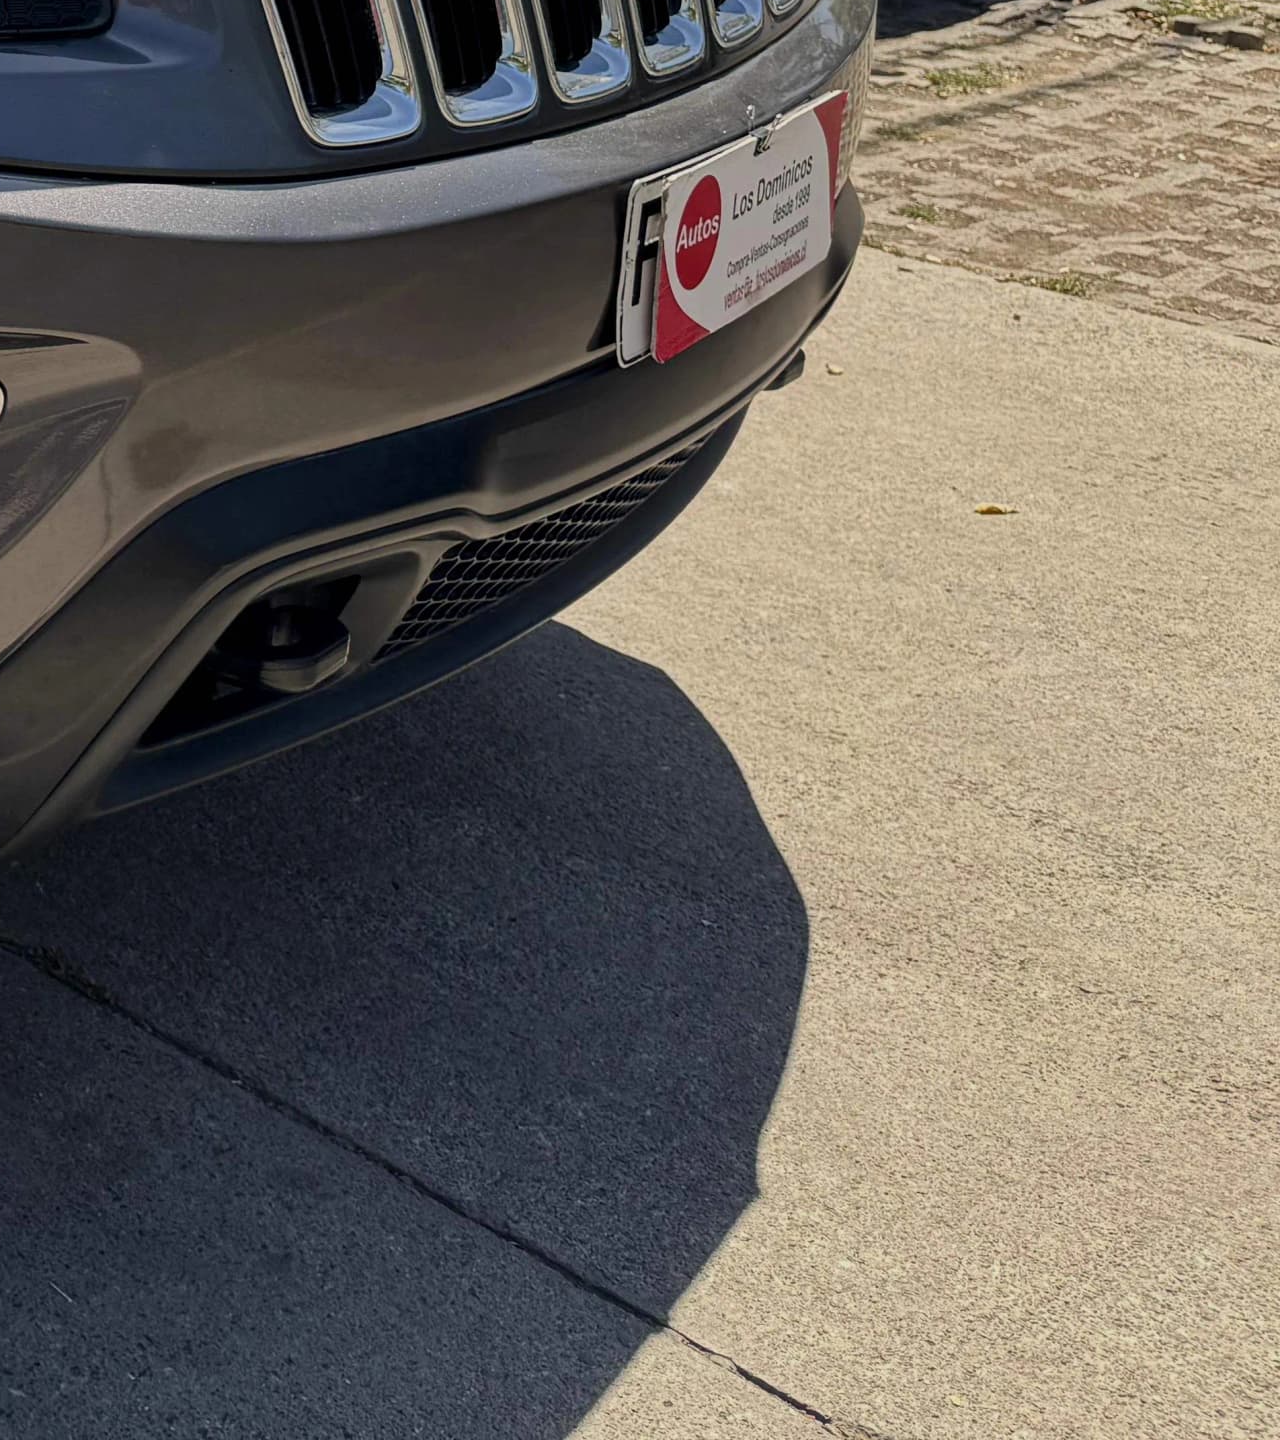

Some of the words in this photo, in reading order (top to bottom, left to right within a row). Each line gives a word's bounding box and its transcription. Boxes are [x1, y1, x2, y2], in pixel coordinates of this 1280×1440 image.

[732, 191, 754, 221] Los
[756, 155, 813, 207] Dominicos
[772, 195, 794, 225] desde
[676, 214, 720, 254] Autos
